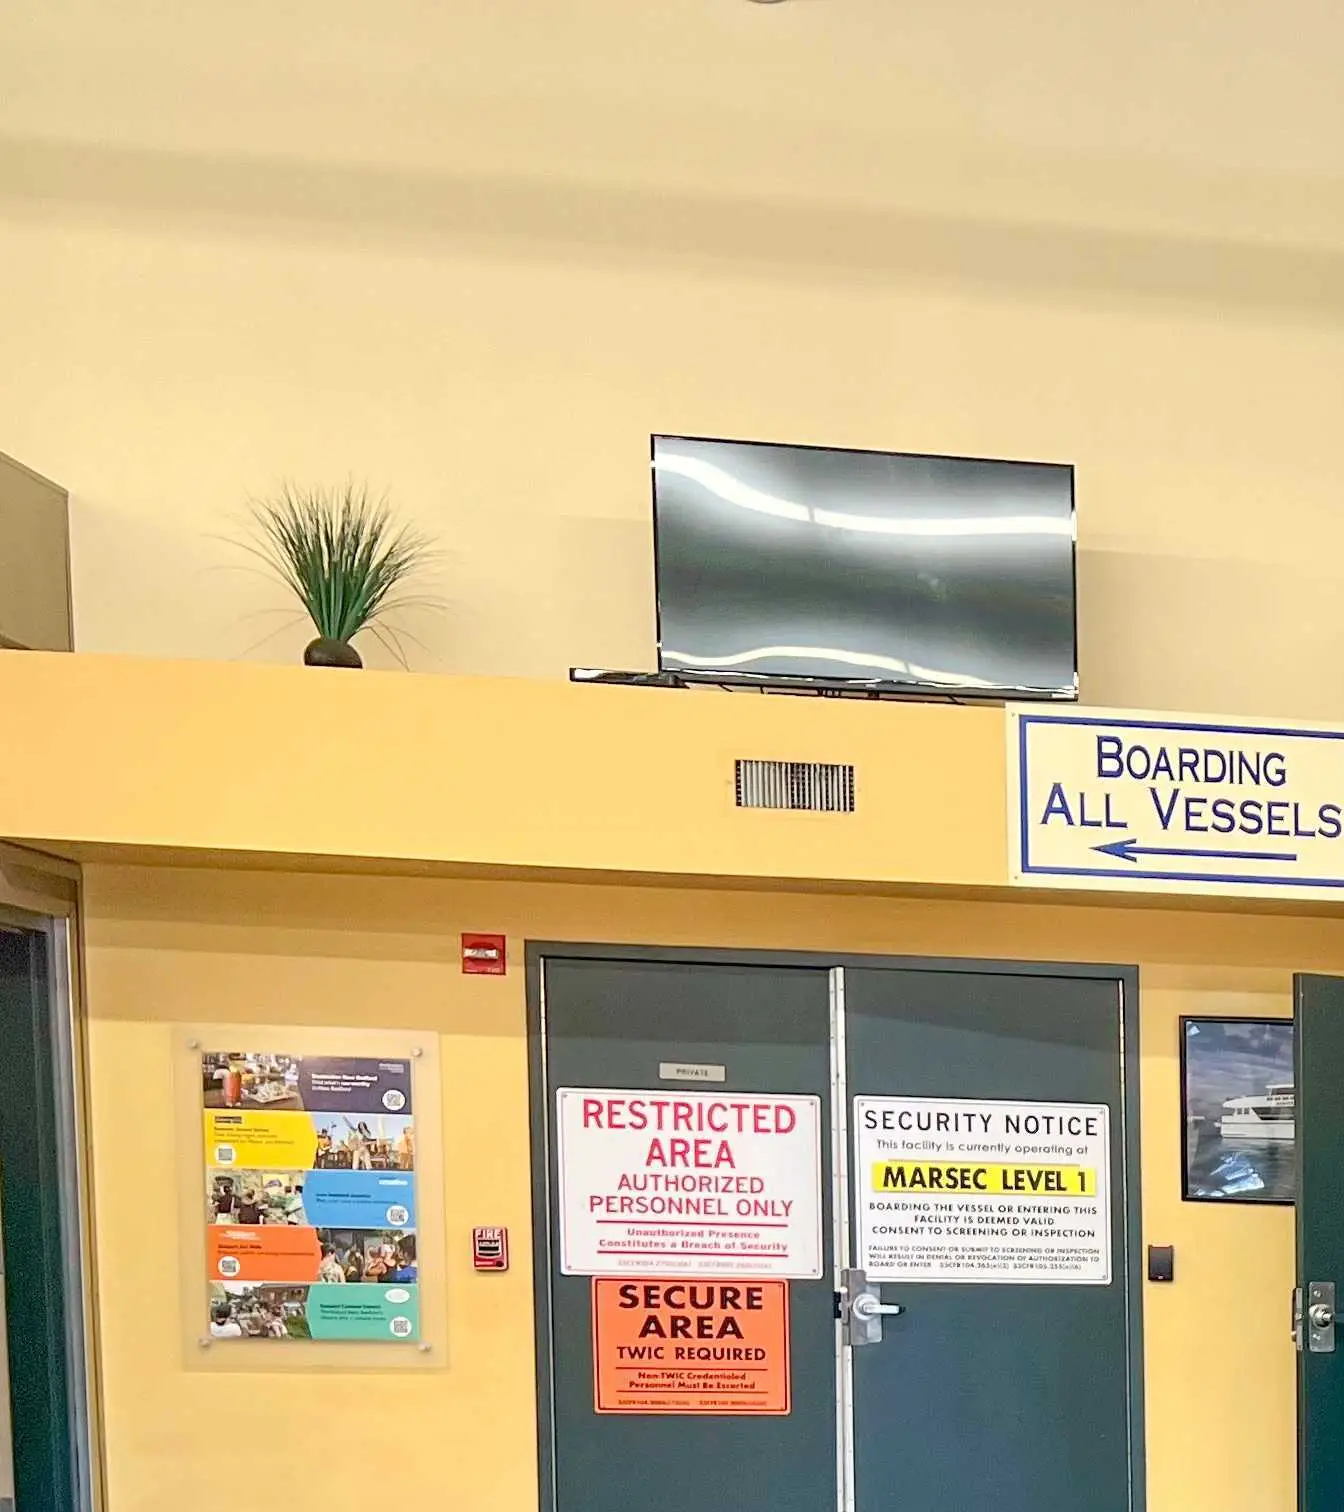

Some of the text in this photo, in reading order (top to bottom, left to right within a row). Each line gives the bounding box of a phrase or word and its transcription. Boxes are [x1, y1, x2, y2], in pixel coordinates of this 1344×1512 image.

[1096, 734, 1287, 787] BOARDING
[1040, 782, 1343, 838] ALL VESSELS
[675, 1067, 709, 1077] PRIVATE
[583, 1098, 796, 1134] RESTRICTED
[864, 1110, 1097, 1136] SECURITY NOTICE
[645, 1138, 736, 1169] AREA
[876, 1139, 1088, 1156] This facility is currently operating at
[617, 1174, 764, 1193] AUTHORIZED
[883, 1166, 1086, 1192] MARSEC LEVEL 1
[589, 1195, 794, 1217] PERSONNEL ONLY
[869, 1203, 1097, 1215] BOARDING THE VESSEL OR ENTERING THIS
[914, 1215, 1055, 1225] FACILITY IS DEEMED VALID
[627, 1228, 760, 1239] Unauthorized Presence
[872, 1226, 924, 1235] CONSENT
[928, 1227, 942, 1235] TO
[946, 1227, 1008, 1236] SCREENING
[1031, 1229, 1095, 1238] INSPECTION
[599, 1239, 666, 1248] Constitutes
[681, 1240, 721, 1249] Breach
[725, 1241, 736, 1250] of
[740, 1242, 788, 1252] Security
[618, 1284, 763, 1310] SECURE
[638, 1314, 744, 1339] AREA
[616, 1346, 766, 1361] TWIC REQUIRED
